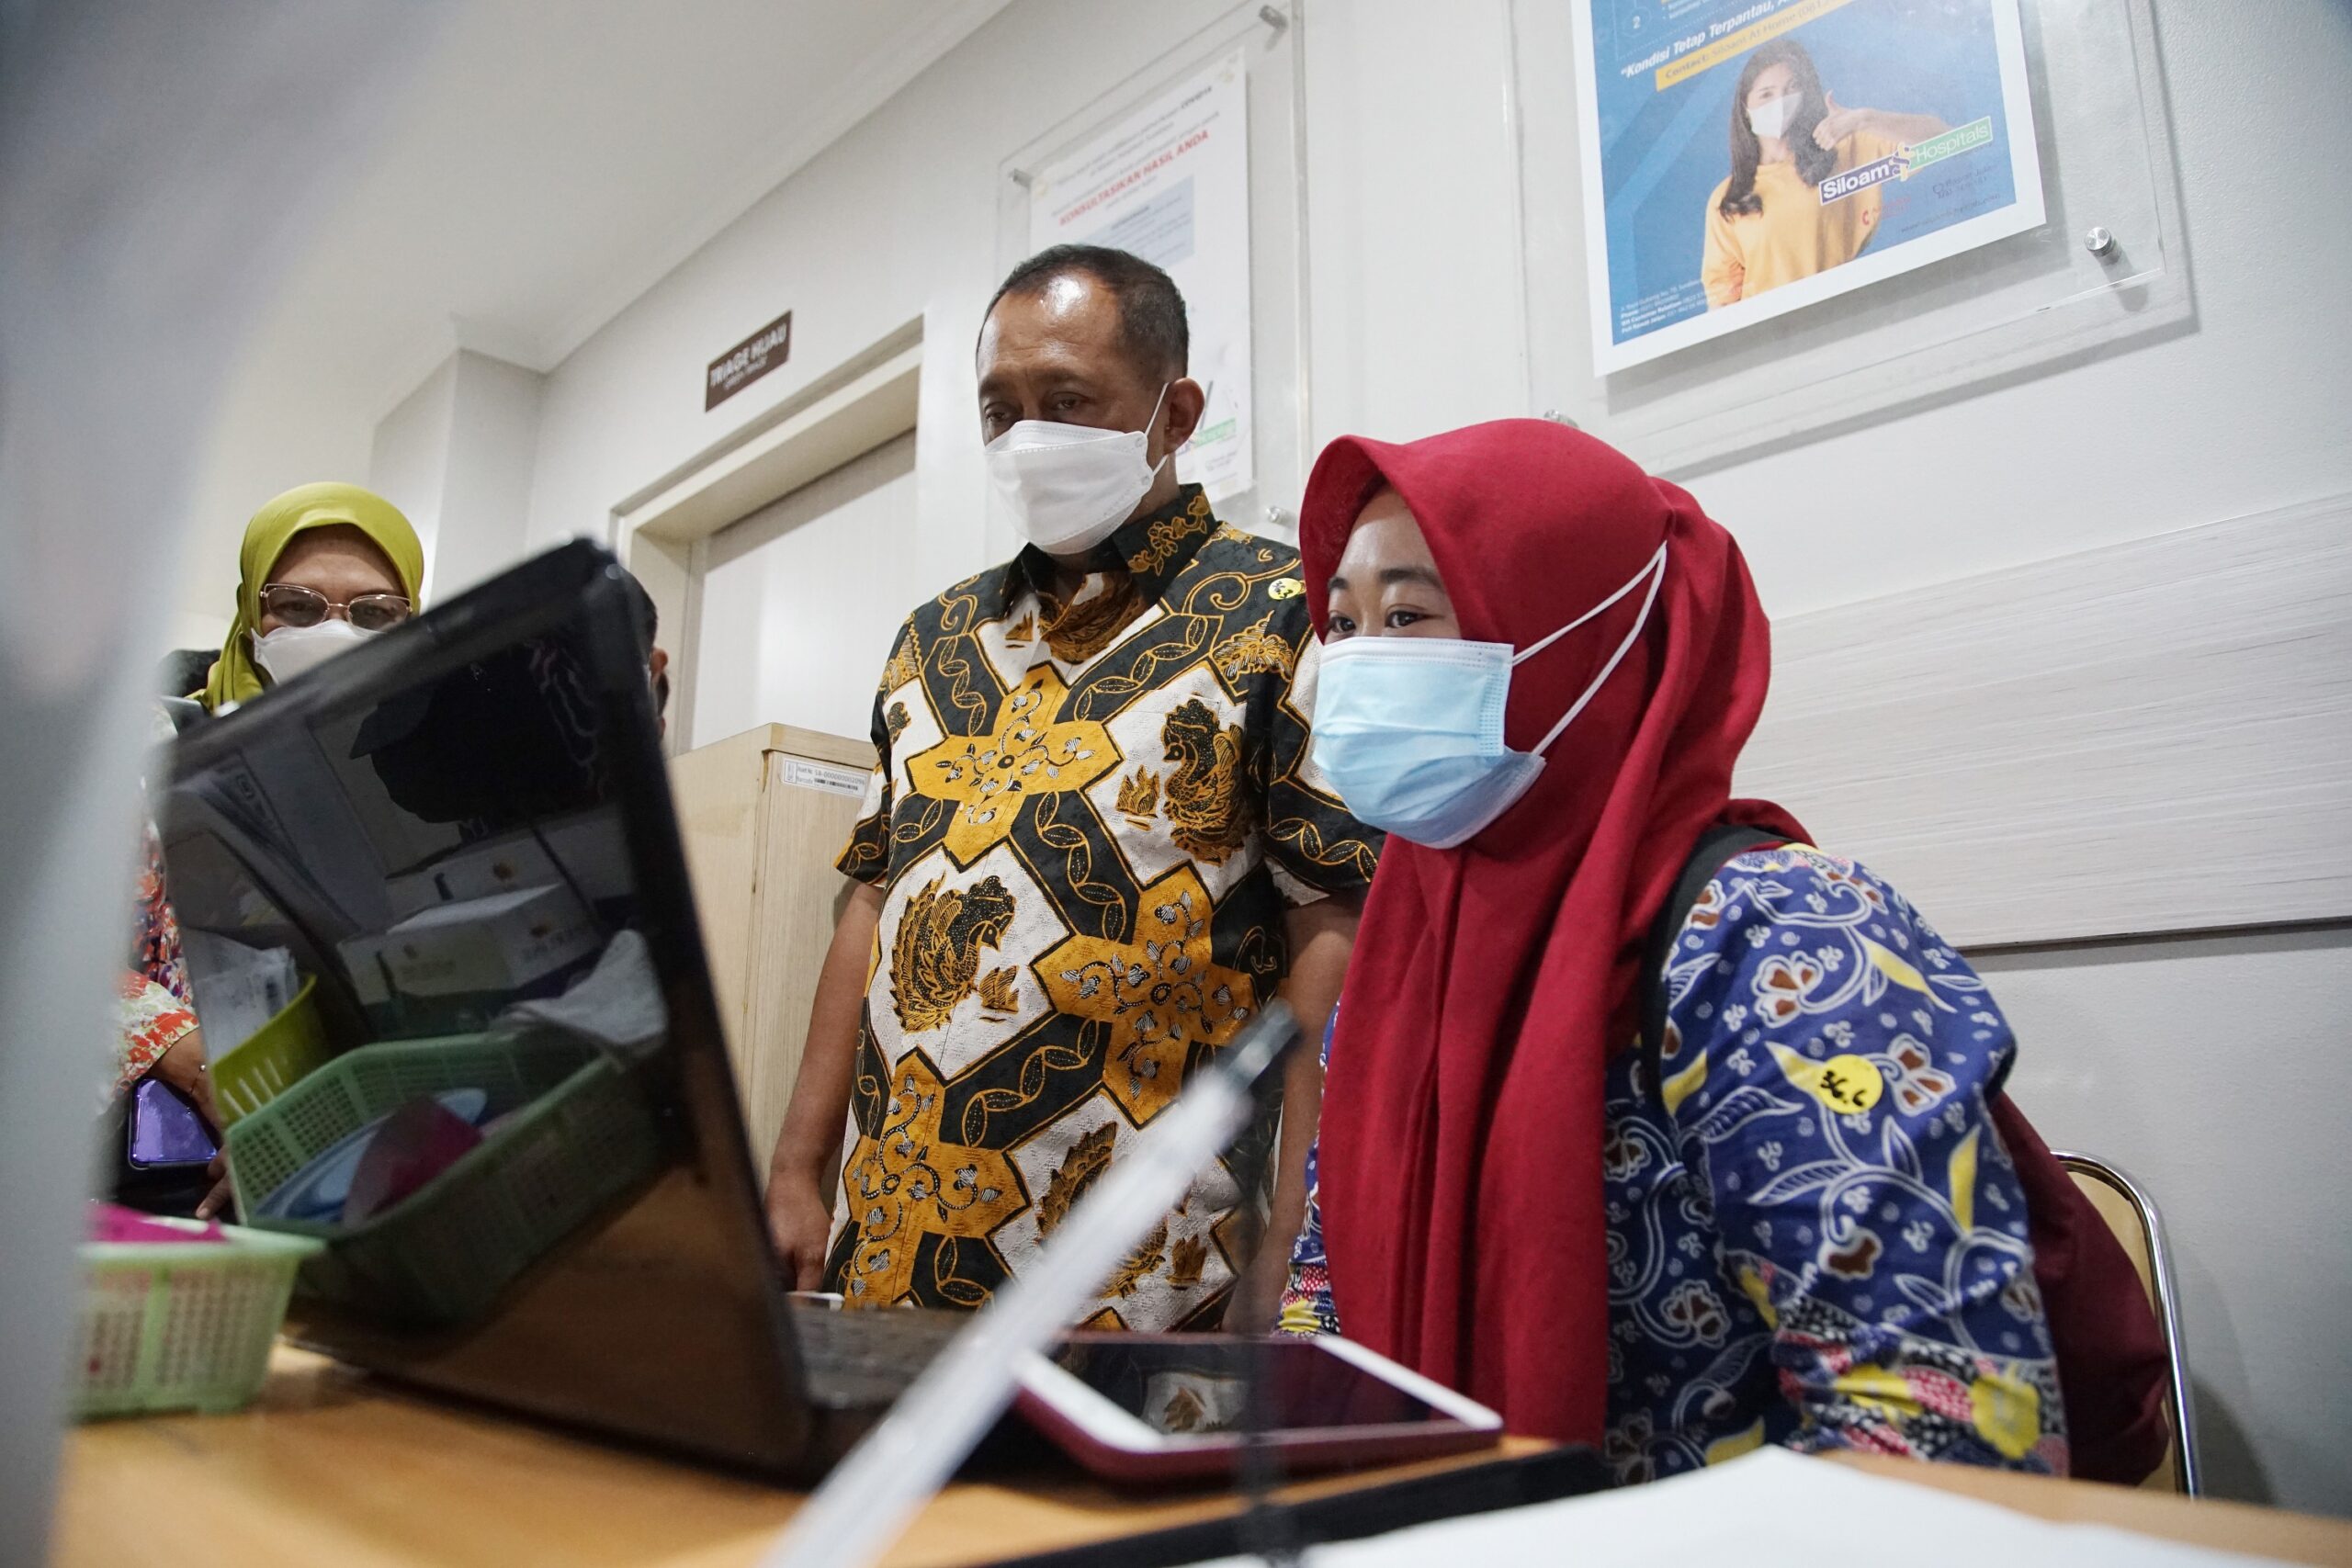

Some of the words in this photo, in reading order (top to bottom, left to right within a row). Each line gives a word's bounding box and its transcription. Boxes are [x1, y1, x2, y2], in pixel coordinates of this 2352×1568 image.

[1673, 31, 1706, 55] Tetap
[1709, 1, 1775, 39] Terpantau,
[1176, 130, 1209, 156] ANDA
[1823, 164, 1890, 199] Siloam
[1916, 124, 1988, 163] Hospitals
[1820, 1070, 1867, 1108] 36.6
